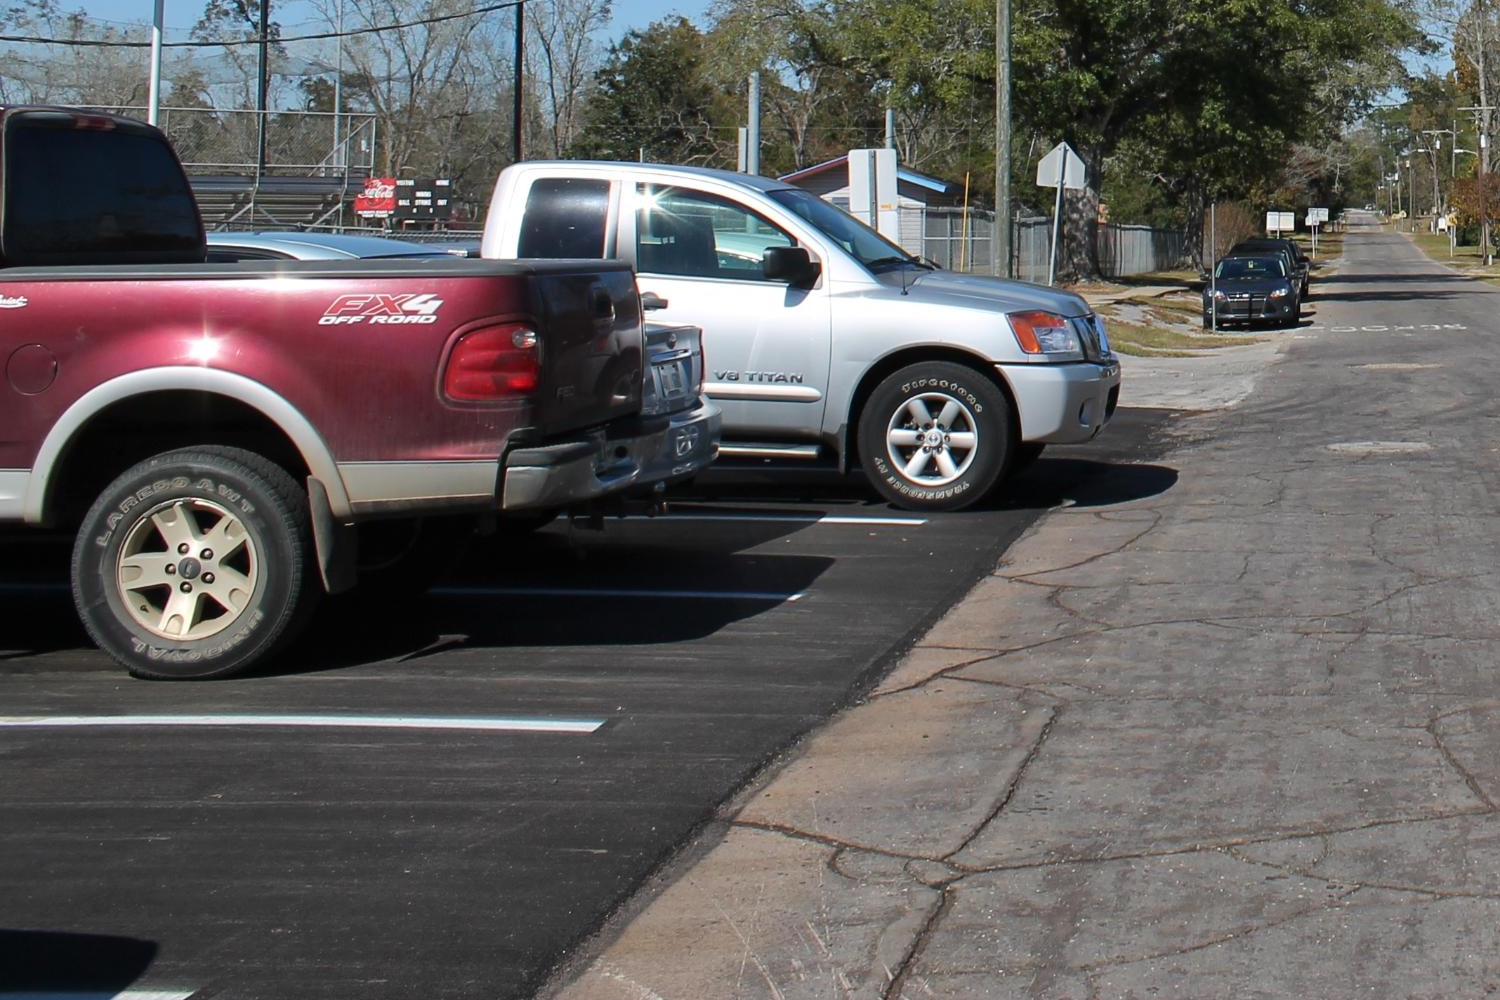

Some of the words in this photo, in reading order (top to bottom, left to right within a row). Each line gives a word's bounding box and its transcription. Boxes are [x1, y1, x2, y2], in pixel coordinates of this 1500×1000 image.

[324, 294, 444, 315] FX4
[318, 315, 365, 325] OFF
[368, 315, 437, 324] ROAD
[713, 369, 739, 381] V8
[745, 370, 804, 383] TITAN
[96, 476, 190, 546] LAREDO
[196, 478, 255, 514] AWT
[131, 609, 264, 662] UNIROYAL
